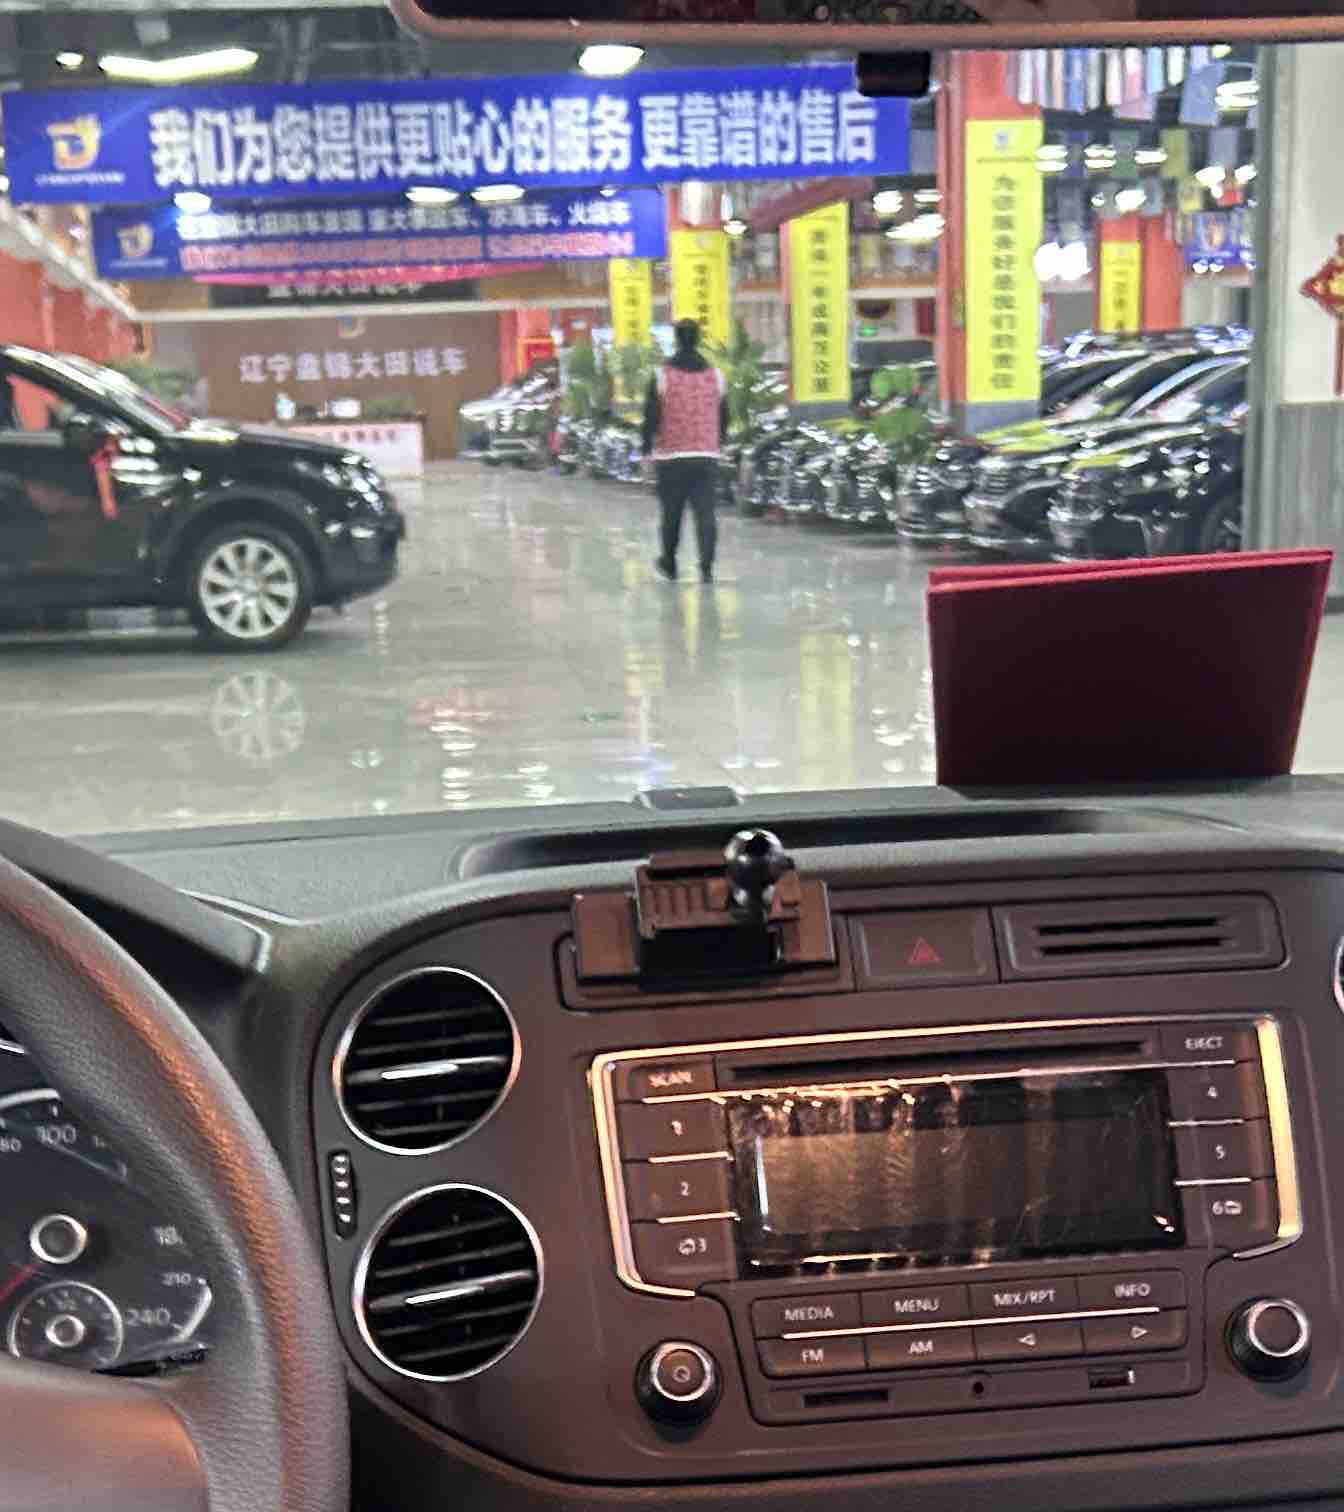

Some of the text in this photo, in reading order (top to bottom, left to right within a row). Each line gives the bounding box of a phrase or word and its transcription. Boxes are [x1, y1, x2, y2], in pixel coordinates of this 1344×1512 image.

[149, 89, 878, 188] 我们为您提供更贴心的服务 更靠谱的售后
[1184, 1035, 1224, 1050] EJECT
[1207, 1085, 1218, 1099] 4
[36, 1127, 77, 1144] 100
[1214, 1144, 1226, 1160] 5
[680, 1180, 691, 1198] 2
[1212, 1200, 1223, 1216] 6
[784, 1281, 1152, 1321] MEDIA MENU MIX/RPT INFO
[801, 1340, 934, 1364] FM AM
